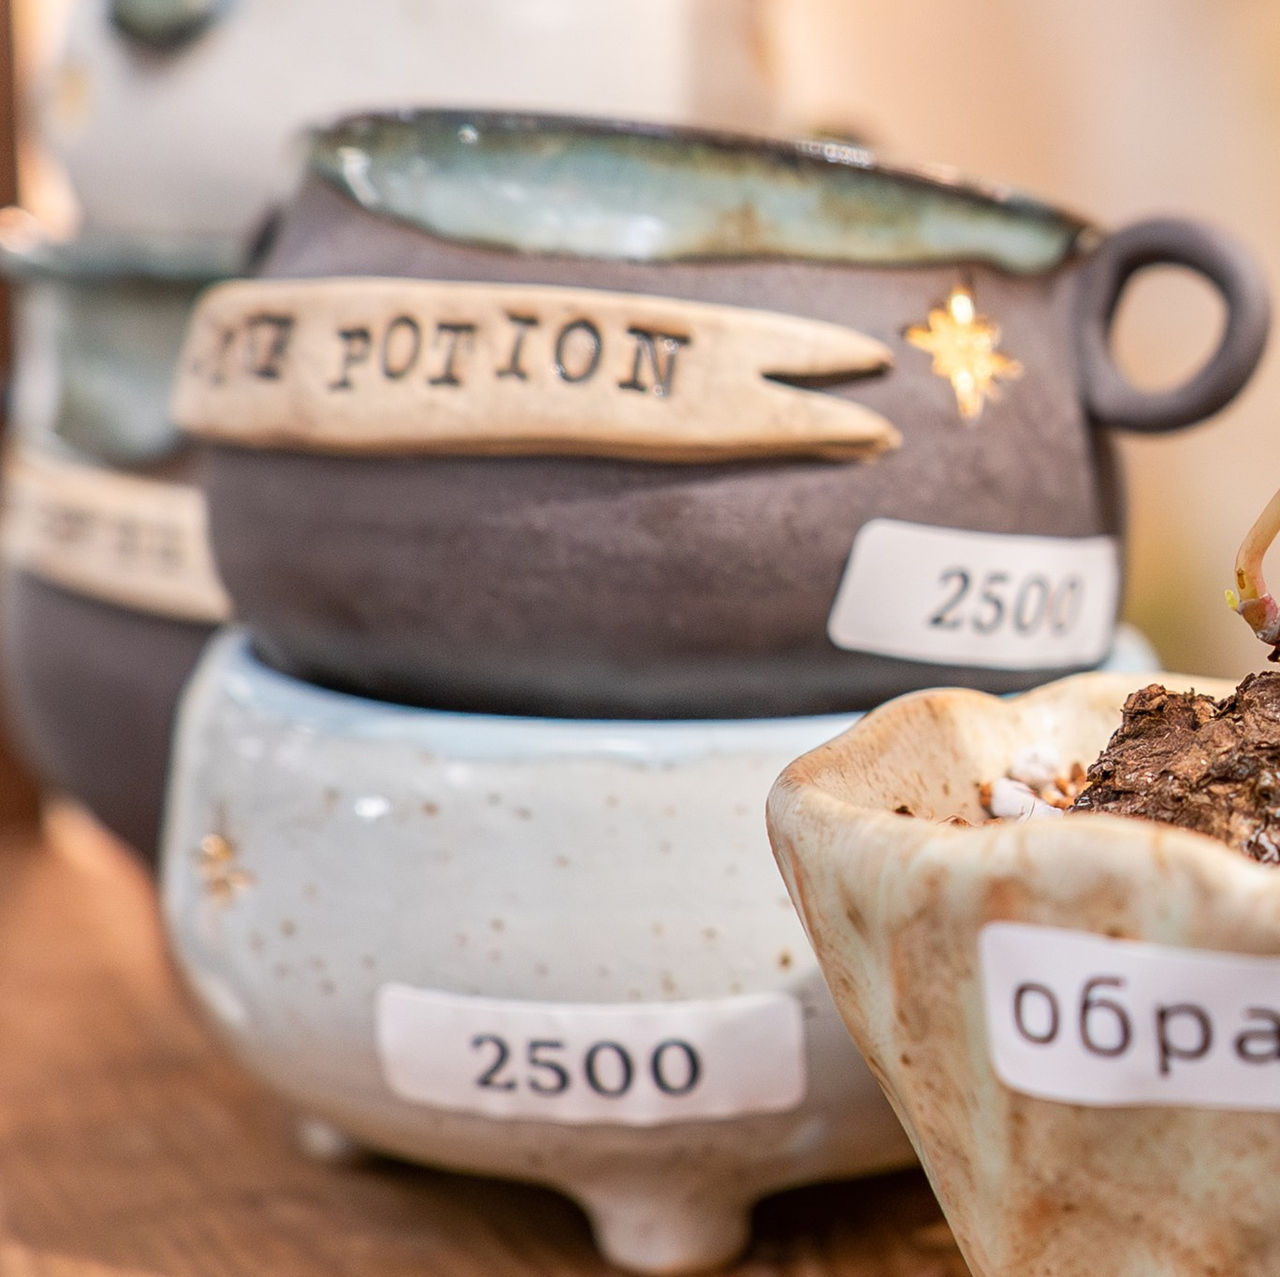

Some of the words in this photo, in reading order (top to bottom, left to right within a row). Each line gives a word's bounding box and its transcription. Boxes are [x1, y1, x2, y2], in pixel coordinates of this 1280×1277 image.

[328, 309, 691, 399] POTION
[928, 566, 1085, 637] 2500
[470, 1033, 703, 1099] 2500
